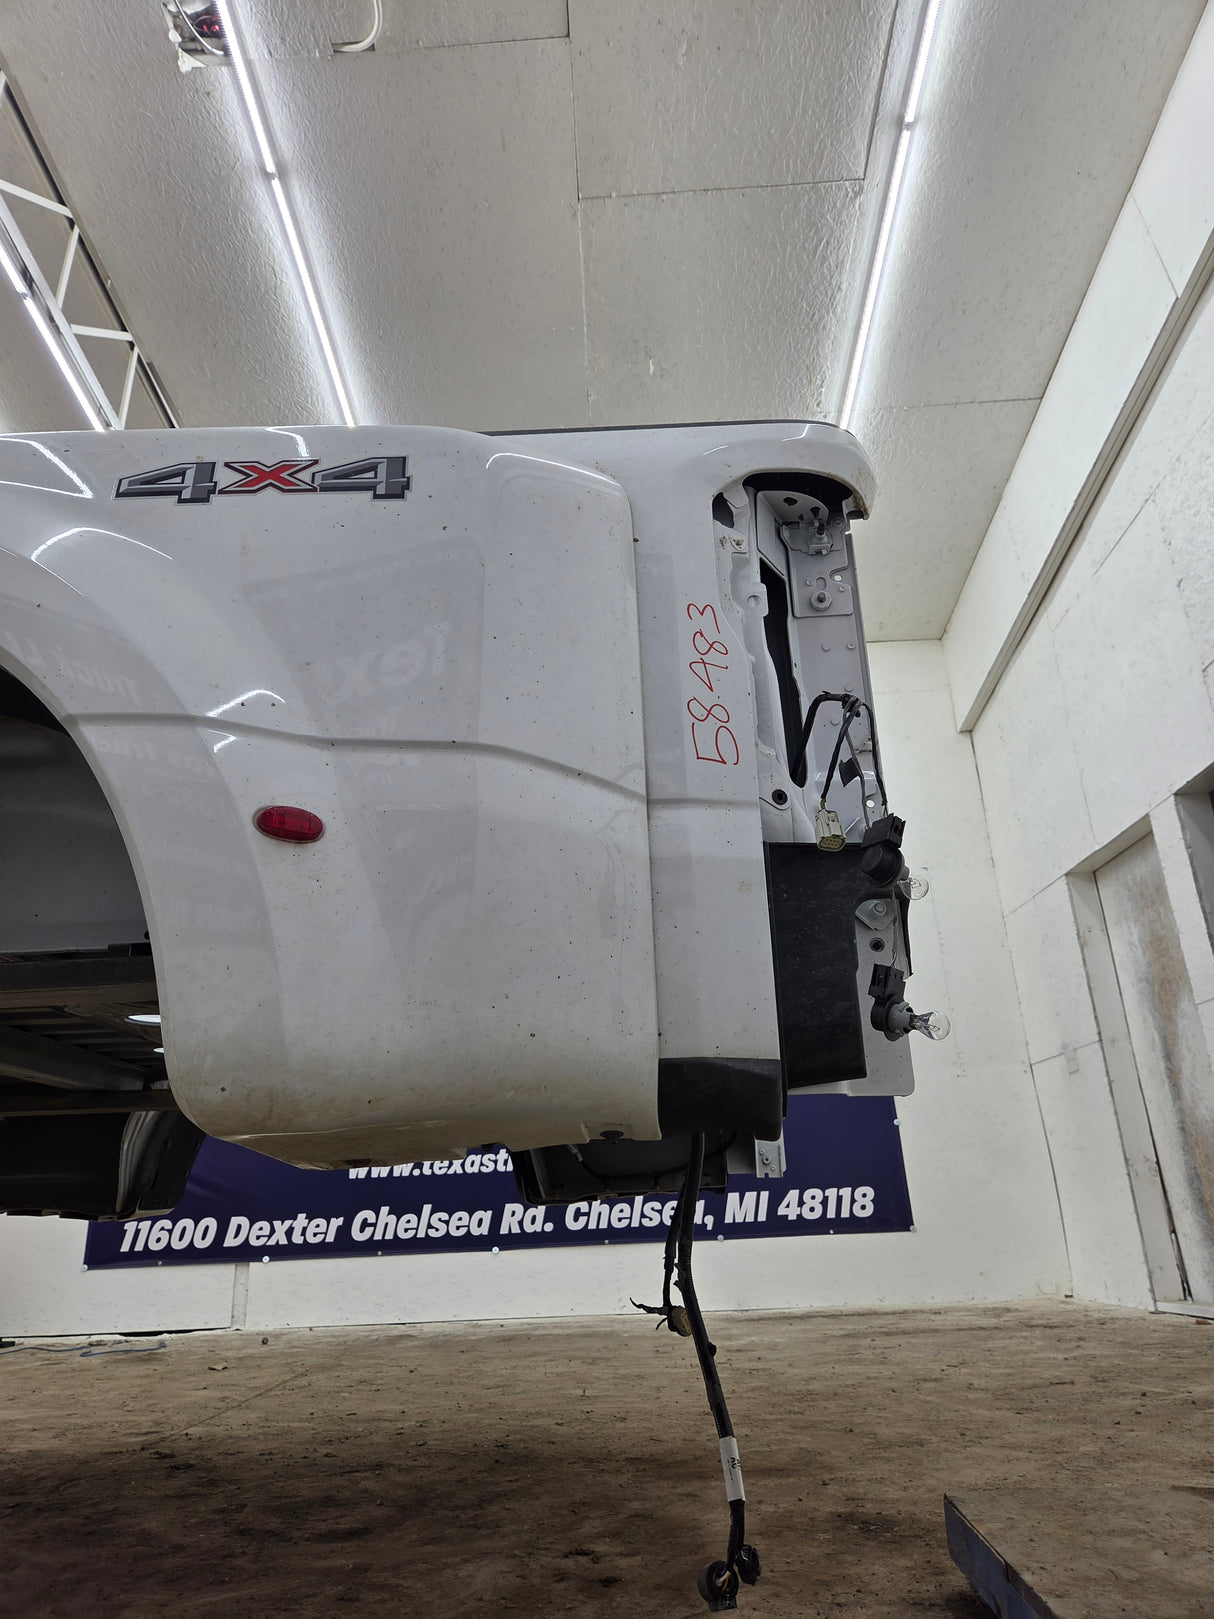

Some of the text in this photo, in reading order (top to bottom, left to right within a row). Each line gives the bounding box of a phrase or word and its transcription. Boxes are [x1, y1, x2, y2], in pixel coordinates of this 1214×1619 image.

[115, 456, 411, 503] 4X4
[687, 603, 740, 765] 58483
[119, 1216, 218, 1252] 11600
[223, 1213, 344, 1248] Dexter
[351, 1204, 492, 1241] Chelsea
[499, 1203, 554, 1235] Rd.
[724, 1191, 769, 1224] MI
[777, 1186, 875, 1220] 48118
